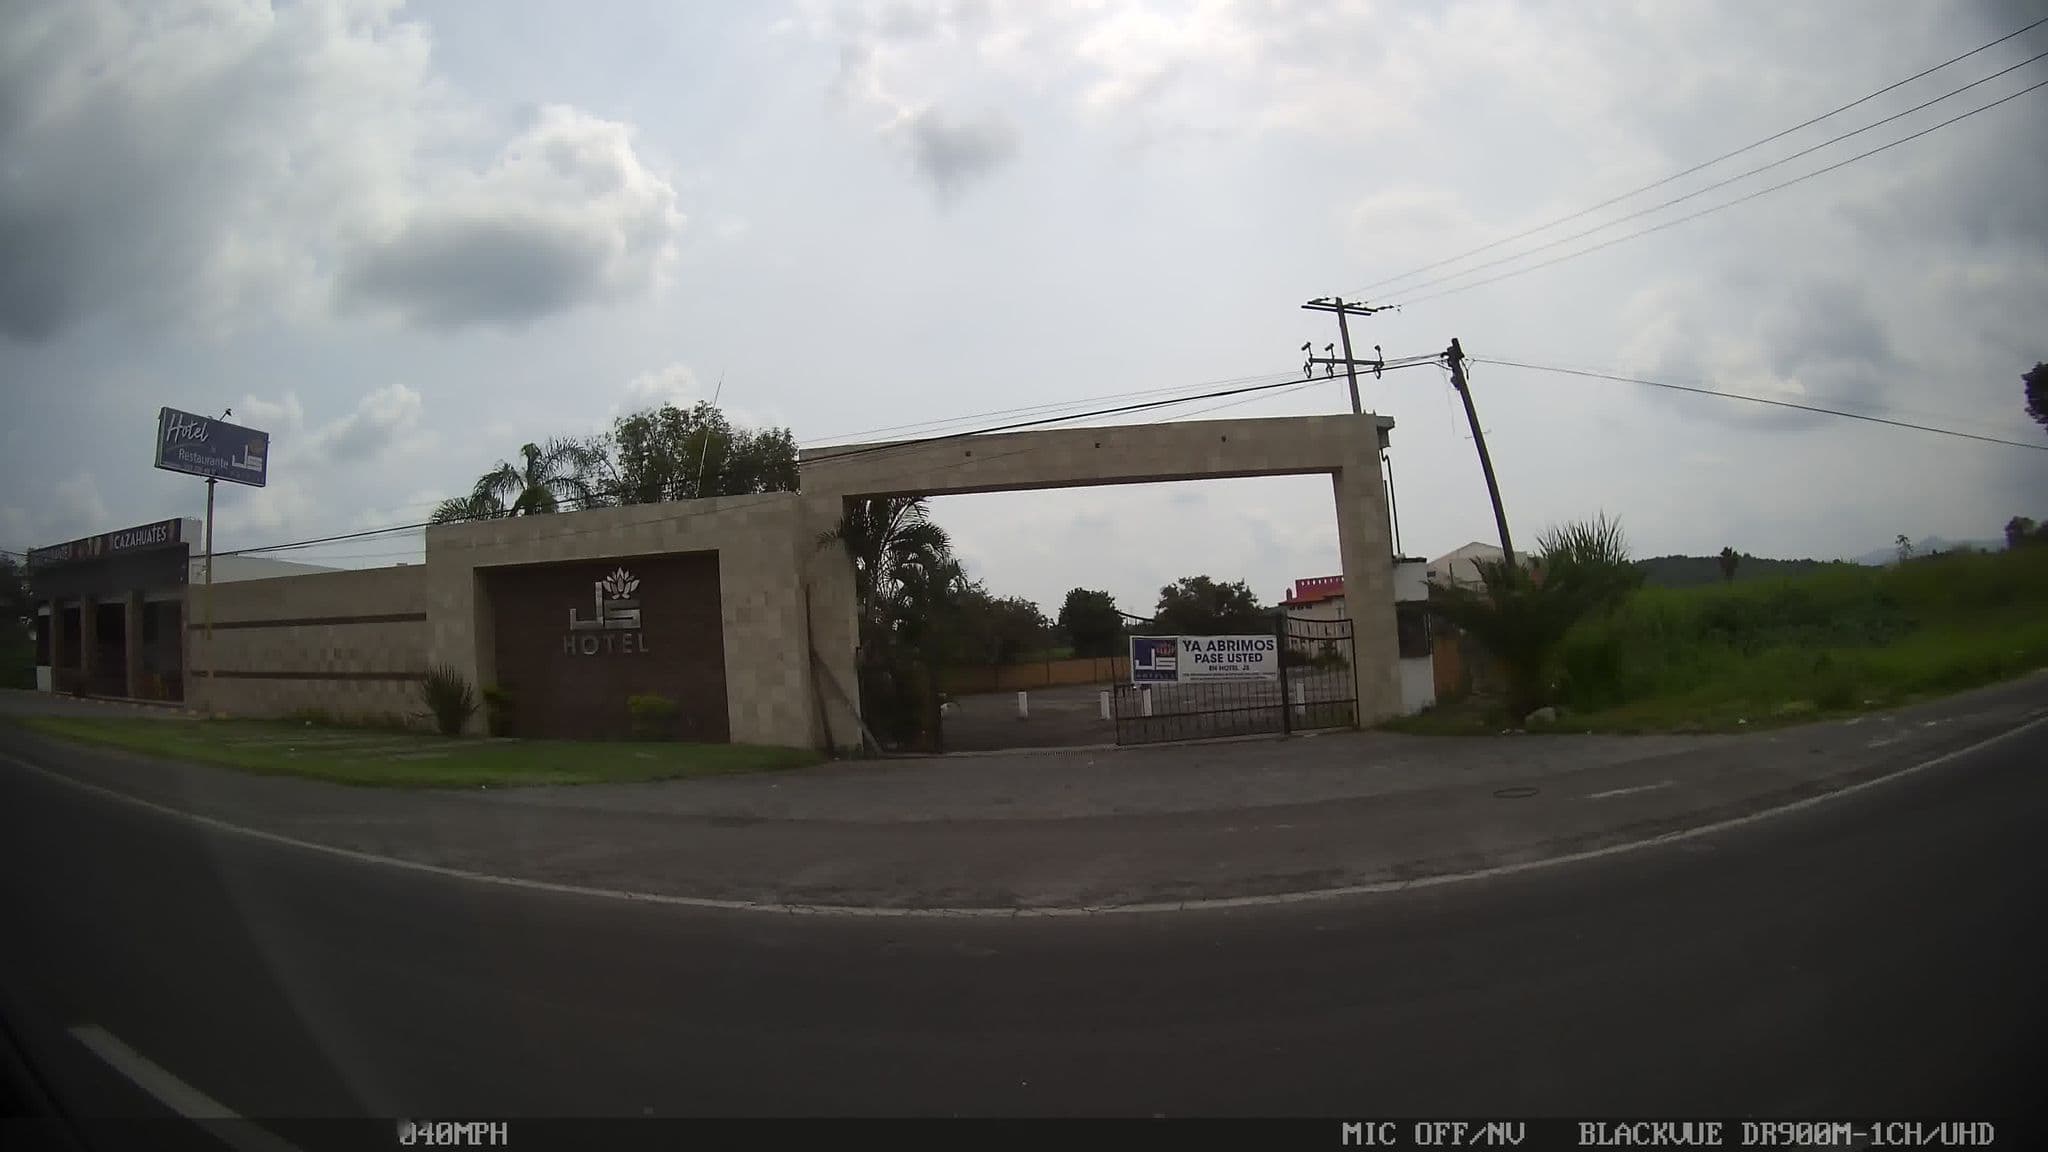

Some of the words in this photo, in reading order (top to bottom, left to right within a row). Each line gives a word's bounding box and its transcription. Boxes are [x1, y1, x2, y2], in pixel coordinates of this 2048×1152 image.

[166, 413, 208, 443] Hotel
[178, 448, 229, 469] Restaurante
[114, 525, 167, 550] CAZAHUATES
[563, 633, 649, 656] HOTEL
[1182, 640, 1201, 652] YA
[1206, 639, 1275, 652] ABRIMOS
[1194, 653, 1224, 663] PASE
[1227, 653, 1263, 663] USTED
